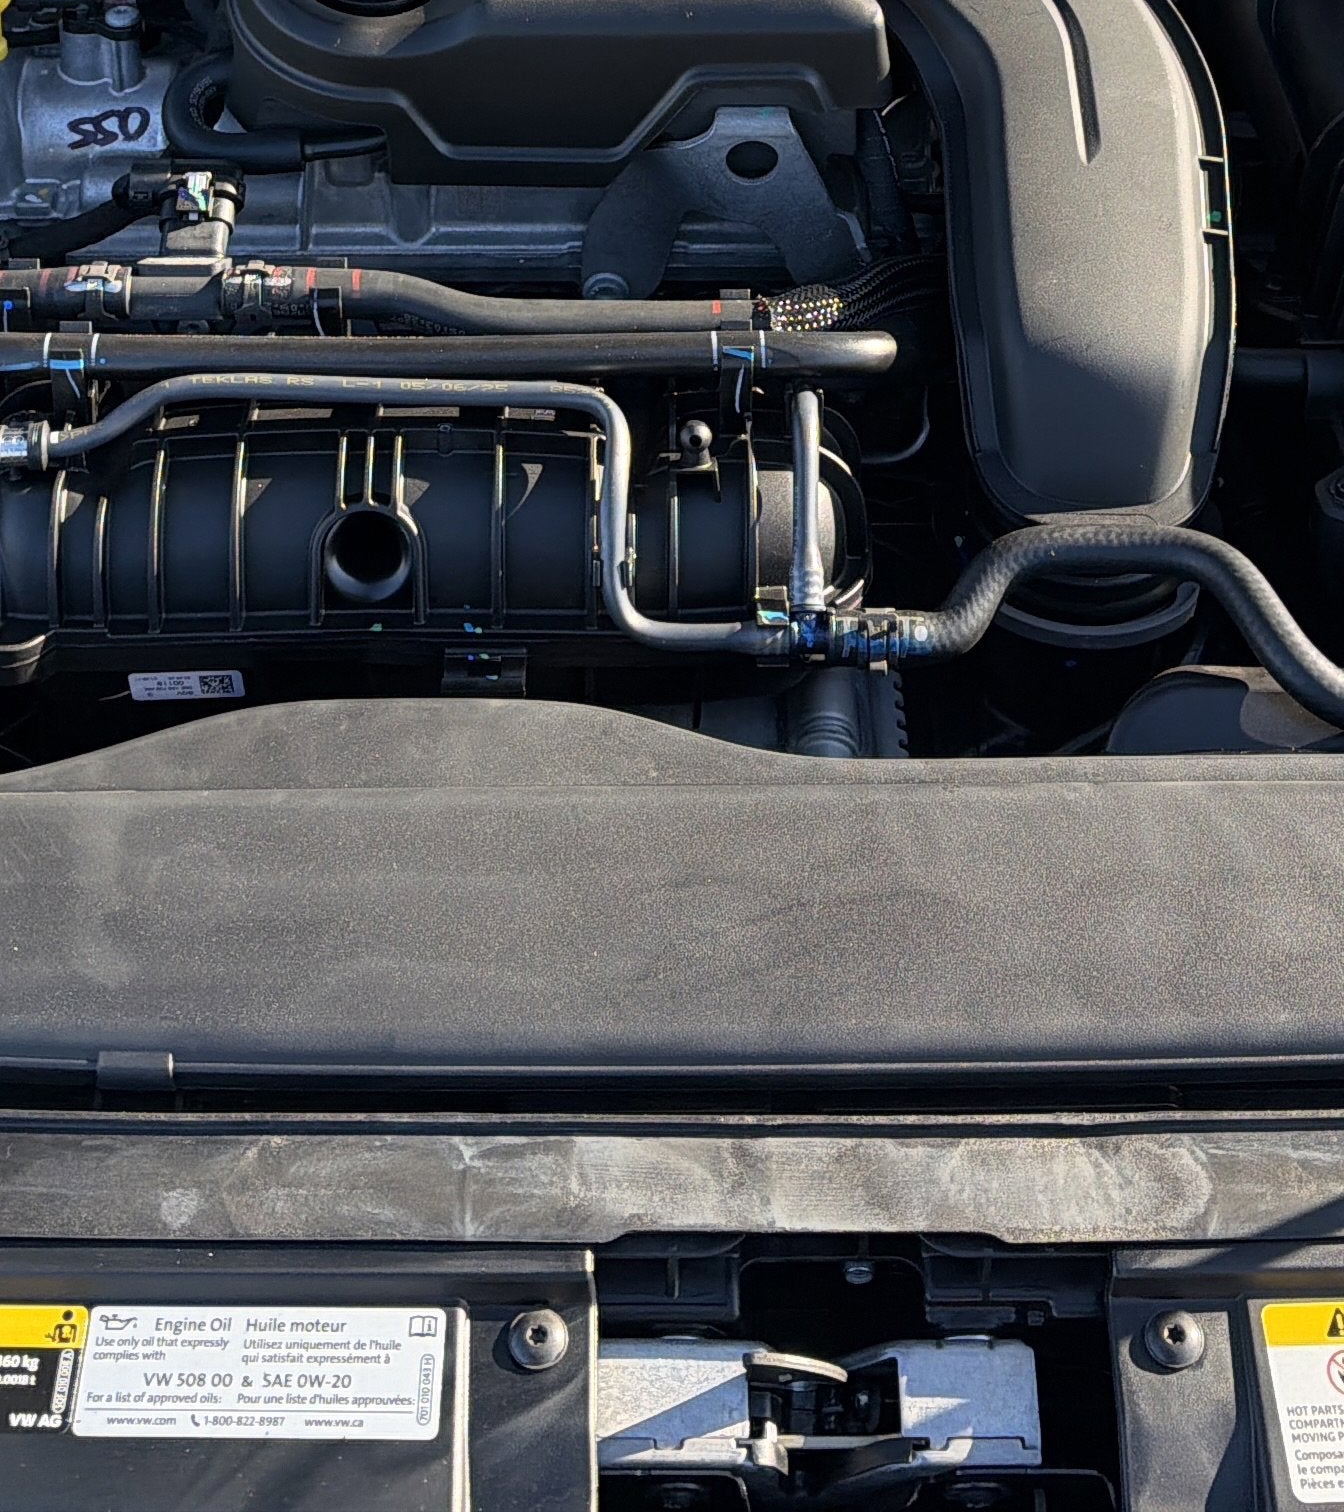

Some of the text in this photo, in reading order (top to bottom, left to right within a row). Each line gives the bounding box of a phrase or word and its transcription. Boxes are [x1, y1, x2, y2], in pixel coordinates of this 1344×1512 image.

[190, 374, 273, 386] TEKLAS
[155, 1317, 232, 1335] Engine Oil
[246, 1318, 347, 1333] Huile moteur
[95, 1336, 230, 1350] Use only oil that expressly
[243, 1339, 402, 1353] Utilisez uniquement de l'huile
[22, 1355, 40, 1371] kg
[92, 1350, 166, 1363] complies with
[241, 1352, 391, 1366] qui satisfait expressément à
[143, 1372, 352, 1388] VW 508 00 & SAE 0W-20
[86, 1392, 105, 1402] For
[115, 1392, 131, 1403] list
[133, 1392, 146, 1403] of
[146, 1393, 197, 1406] approved
[199, 1393, 223, 1404] oils:
[237, 1393, 416, 1408] Pour une liste d'huiles approuvées:
[421, 1387, 431, 1403] 010
[420, 1405, 429, 1422] 701
[1287, 1406, 1308, 1417] HOT
[1311, 1405, 1344, 1416] PARTS
[9, 1413, 63, 1428] VW AG
[106, 1416, 364, 1427] www.vw.com 1-800-822-8987 www.vw.ca
[1291, 1431, 1336, 1443] MOVING
[1297, 1464, 1308, 1475] le
[1300, 1478, 1335, 1490] Pièces
